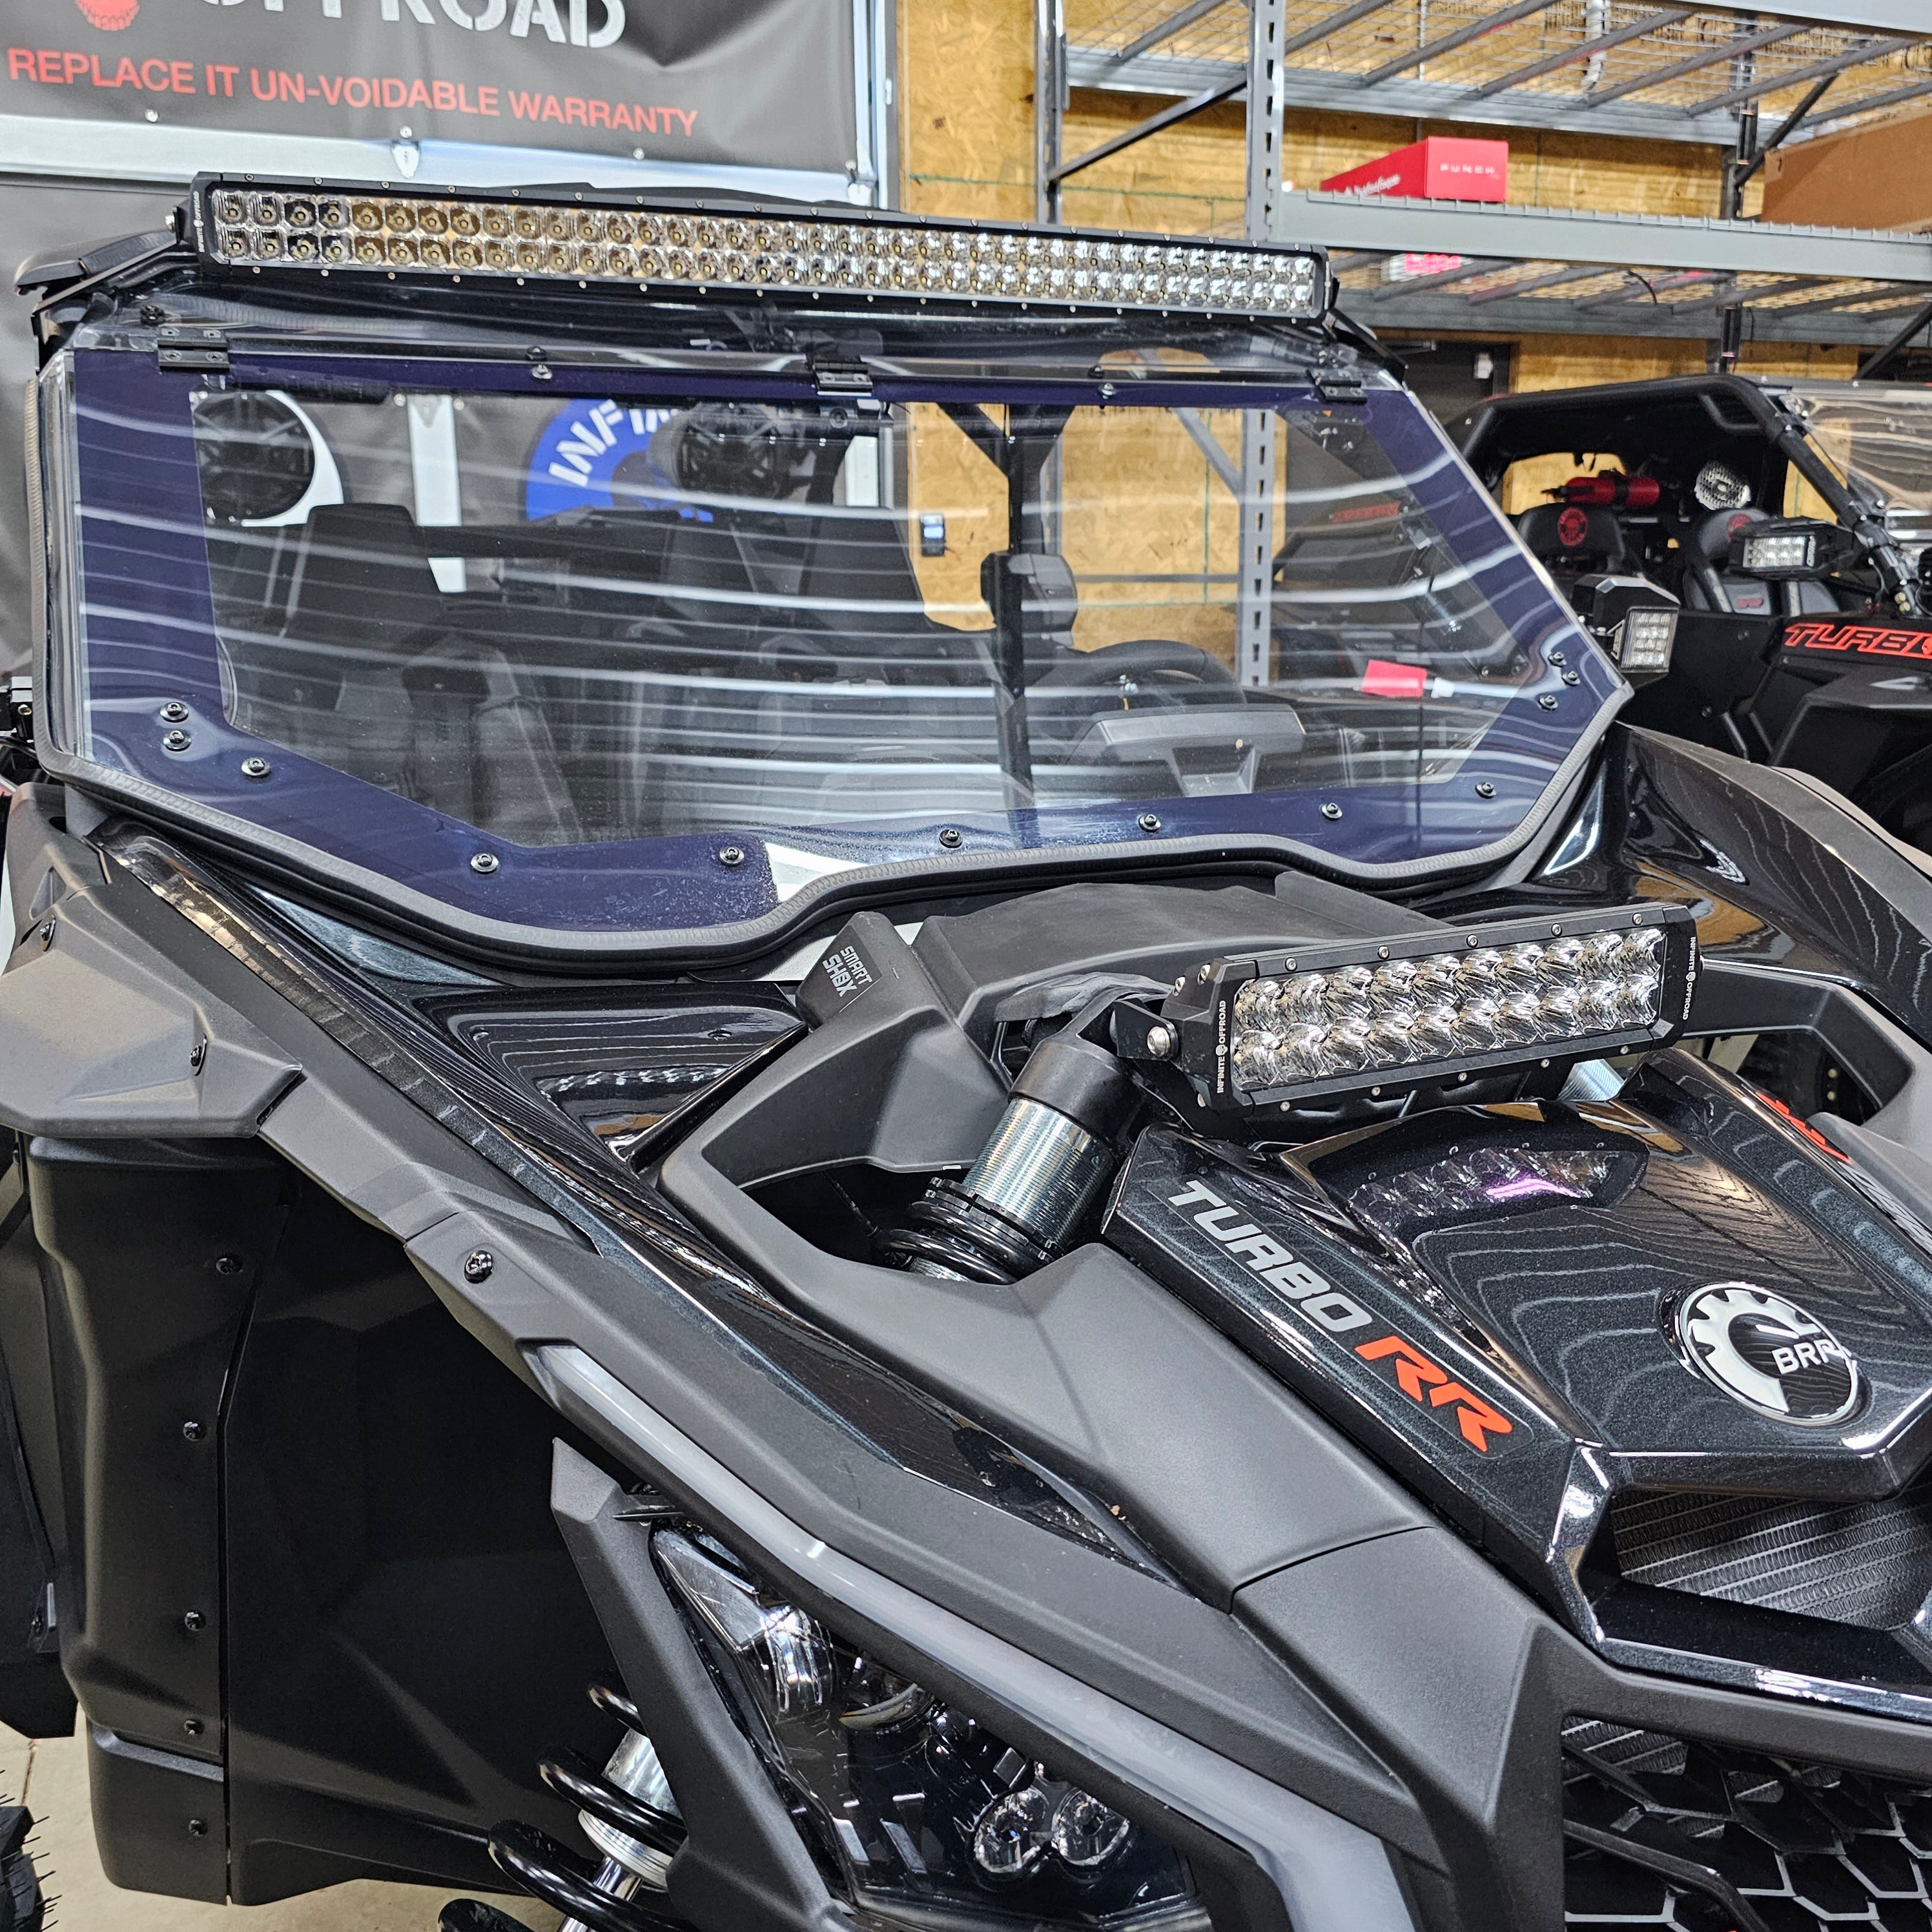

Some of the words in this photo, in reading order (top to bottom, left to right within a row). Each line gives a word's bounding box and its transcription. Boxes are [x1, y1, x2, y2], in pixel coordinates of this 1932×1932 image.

[8, 48, 196, 95] REPLACE
[205, 65, 240, 98] IT
[250, 68, 498, 117] UN-VOIDABLE
[509, 92, 697, 137] WARRANTY
[840, 945, 872, 985] SMART
[1683, 981, 1692, 1020] OFFROAD
[1217, 1056, 1225, 1093] INFINITE
[1168, 1180, 1373, 1332] TURBO
[1355, 1336, 1512, 1452] RR
[1771, 1339, 1836, 1375] BRP
